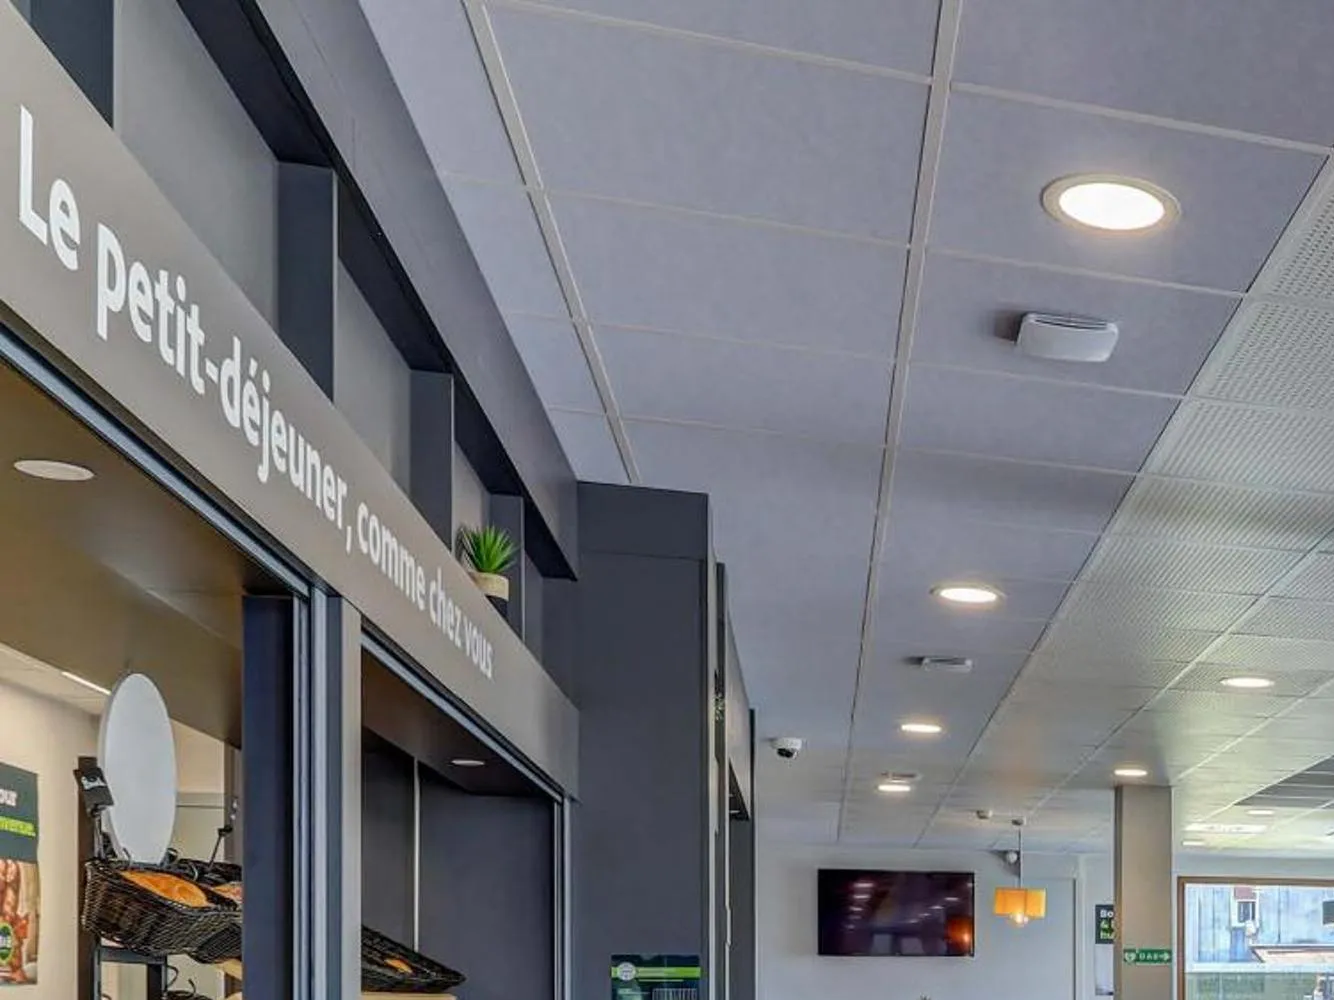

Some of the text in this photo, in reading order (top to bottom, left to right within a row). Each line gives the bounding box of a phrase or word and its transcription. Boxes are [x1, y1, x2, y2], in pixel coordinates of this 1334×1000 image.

[18, 104, 494, 678] Le petit-déjeuner, comme chez vous
